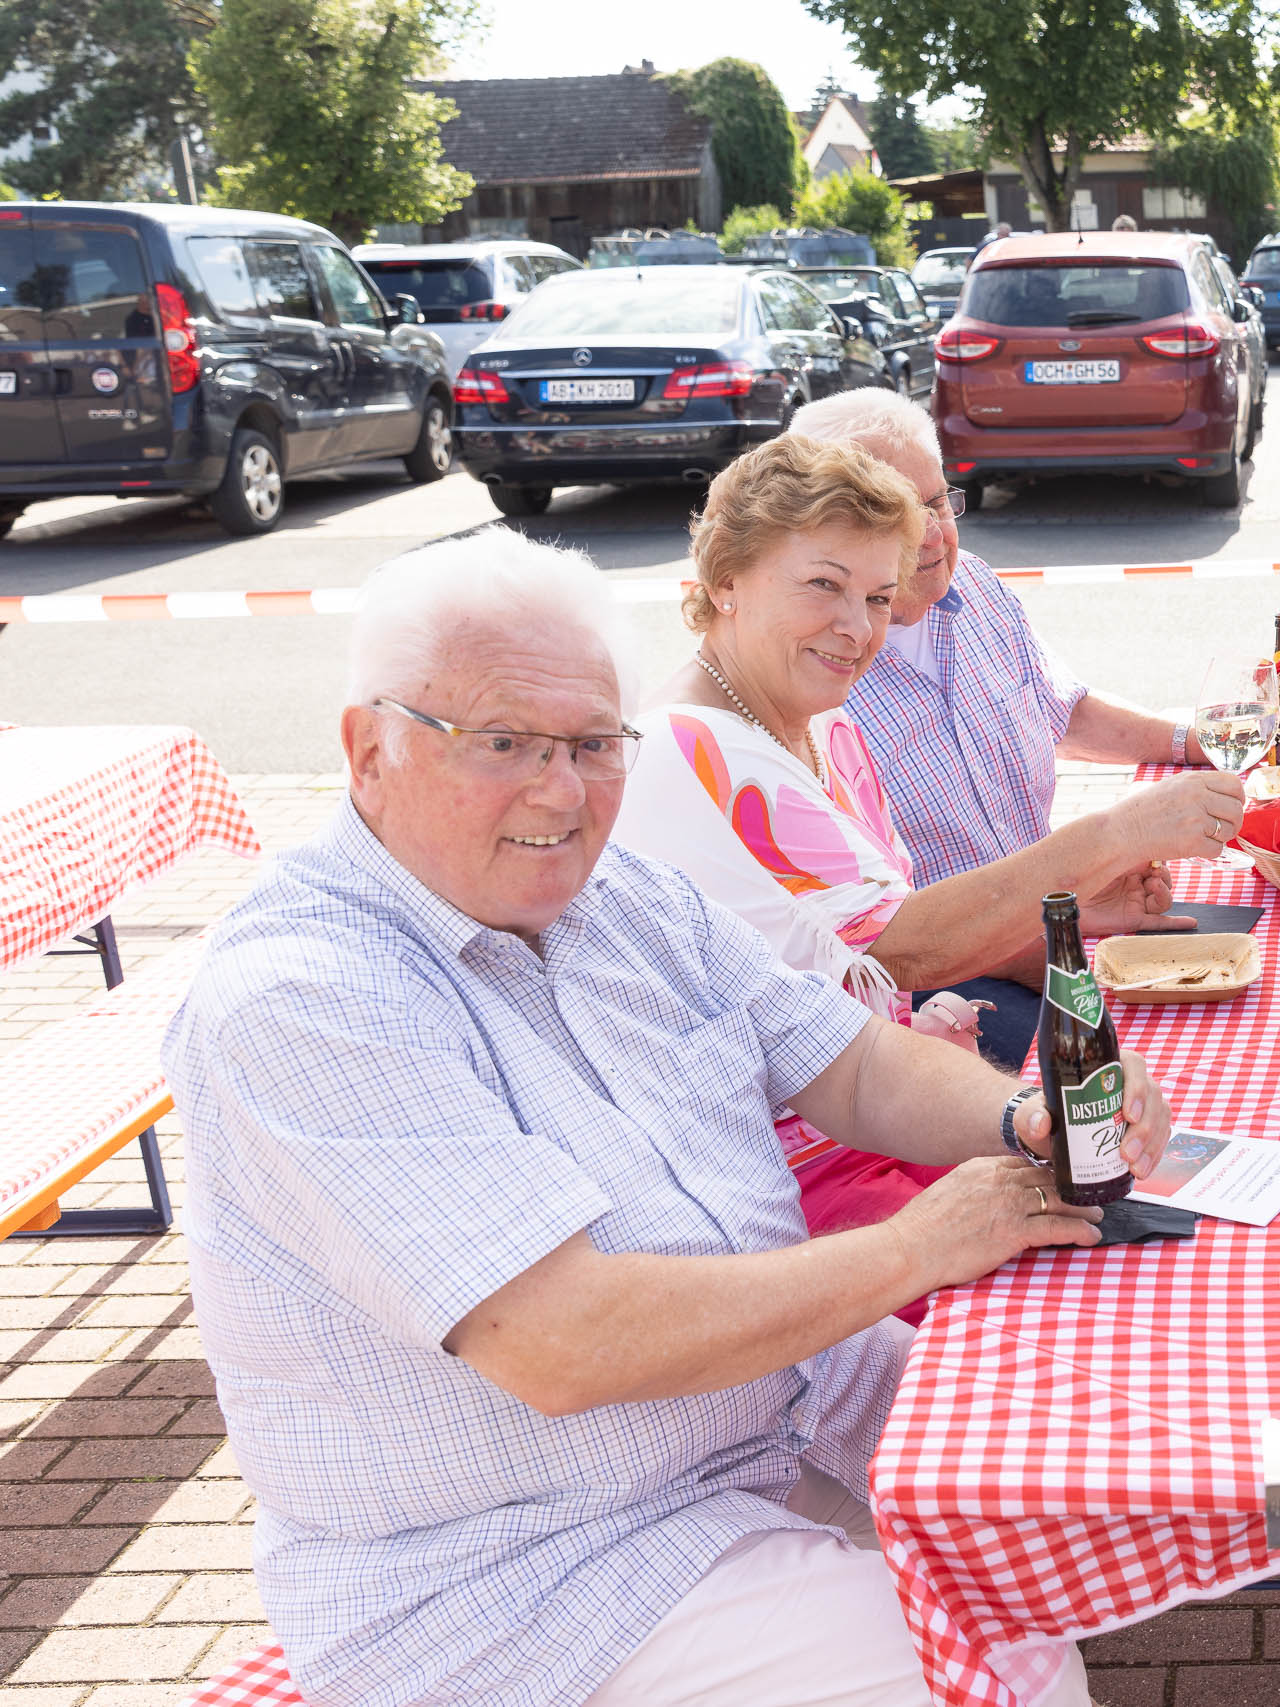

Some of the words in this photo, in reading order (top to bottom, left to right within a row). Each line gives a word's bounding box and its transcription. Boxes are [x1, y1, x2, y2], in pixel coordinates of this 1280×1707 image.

[1034, 363, 1065, 378] OCH
[1074, 363, 1095, 378] GH
[1097, 362, 1117, 378] 56
[599, 382, 631, 398] 2010
[1073, 992, 1099, 1014] Pils
[1091, 1120, 1128, 1157] Pil
